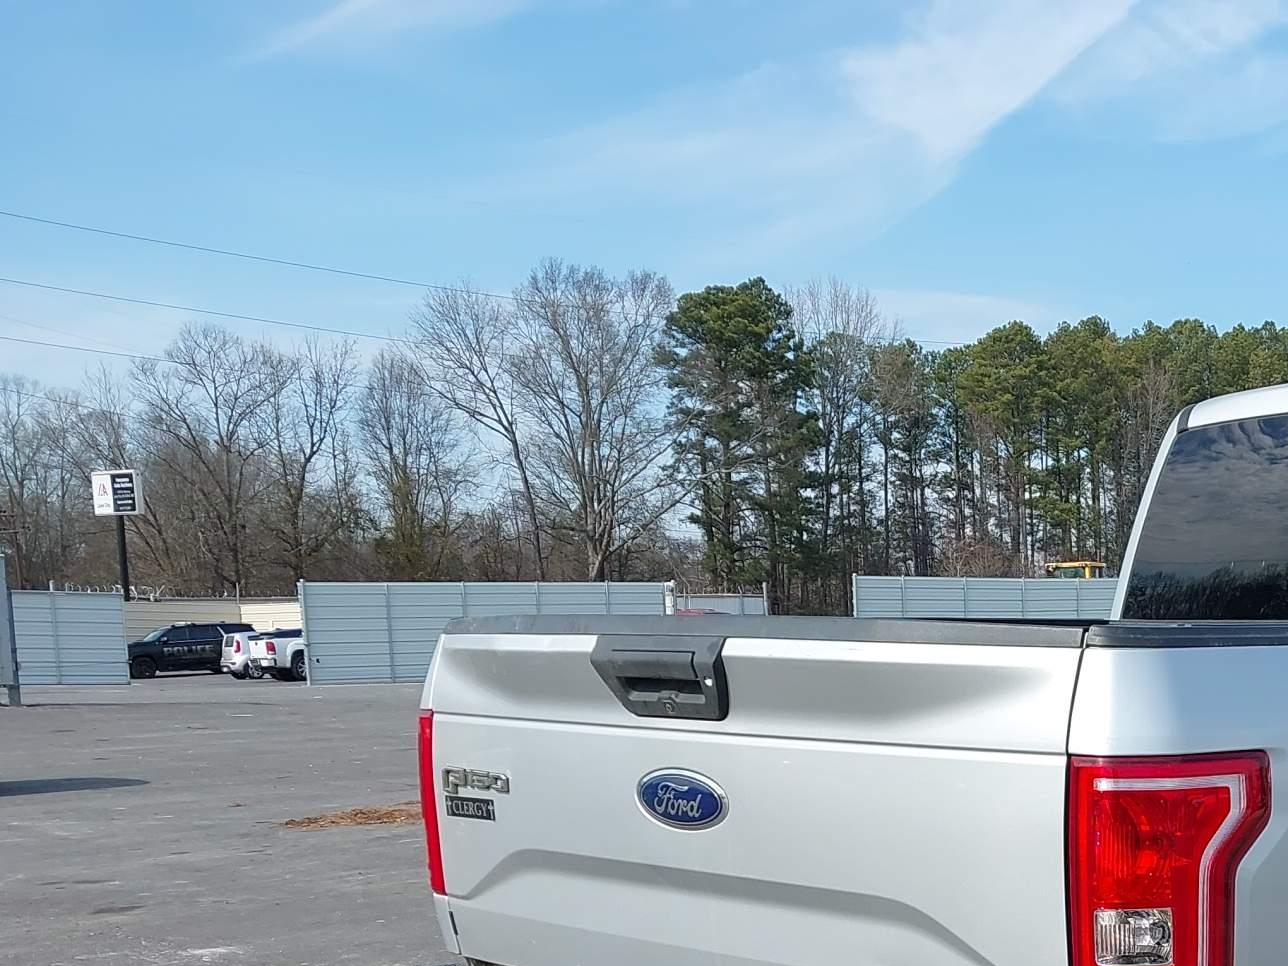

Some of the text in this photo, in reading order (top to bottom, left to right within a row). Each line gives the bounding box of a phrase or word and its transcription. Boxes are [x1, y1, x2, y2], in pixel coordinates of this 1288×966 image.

[163, 644, 214, 657] POLICE
[654, 781, 702, 818] Ford
[452, 800, 488, 817] CLERGY
